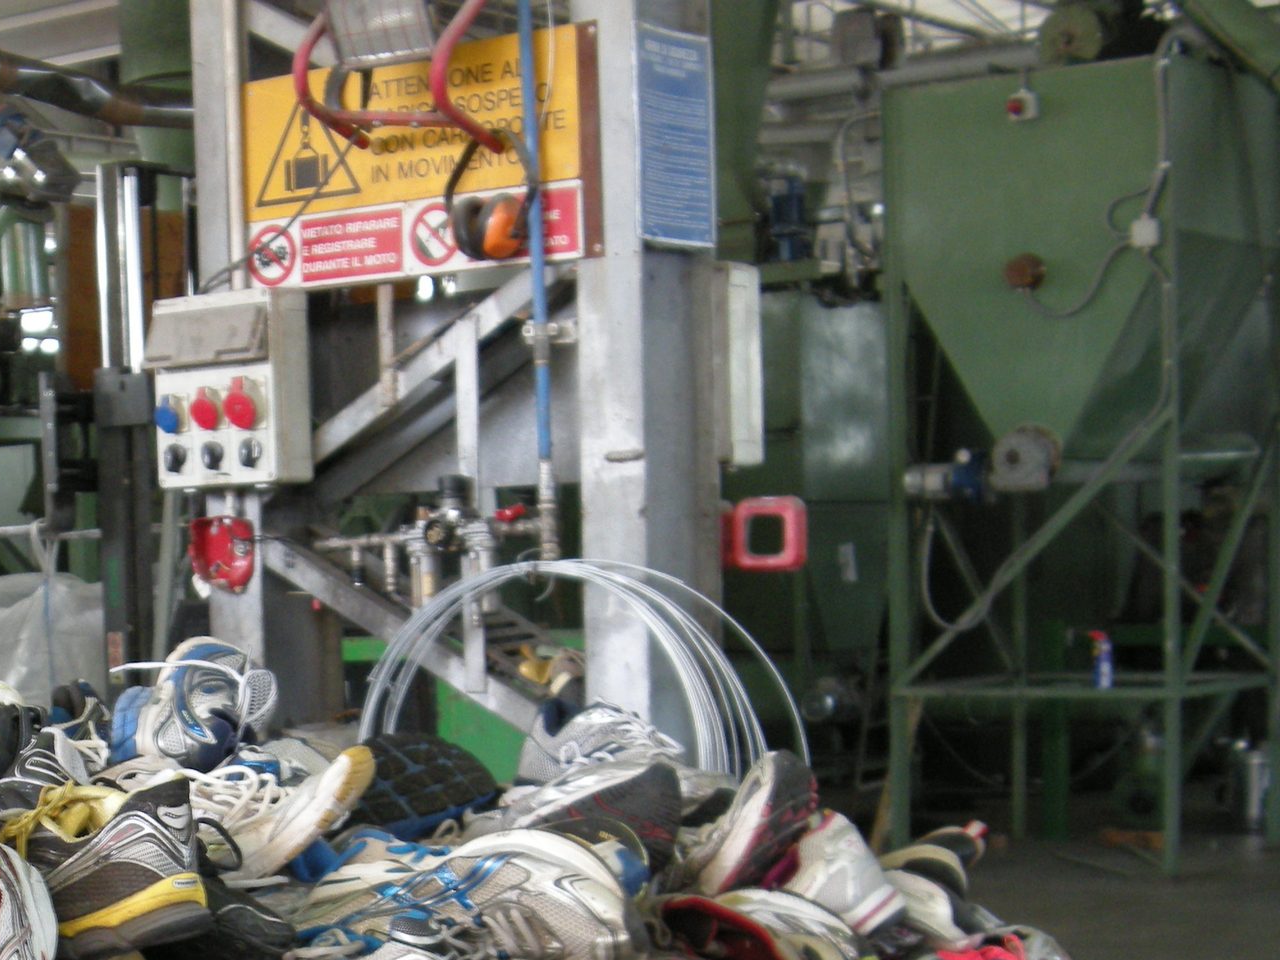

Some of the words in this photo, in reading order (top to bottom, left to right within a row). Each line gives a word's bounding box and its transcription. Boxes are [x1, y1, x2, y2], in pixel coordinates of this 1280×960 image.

[371, 63, 493, 99] ATTENONE
[455, 83, 549, 114] SOSPEO
[371, 164, 389, 183] IN
[302, 224, 343, 239] VIETATO
[302, 245, 310, 256] E
[311, 237, 377, 254] REGISTRARE
[302, 257, 350, 273] DURANTE
[351, 256, 361, 267] IL
[364, 252, 396, 266] MOTO
